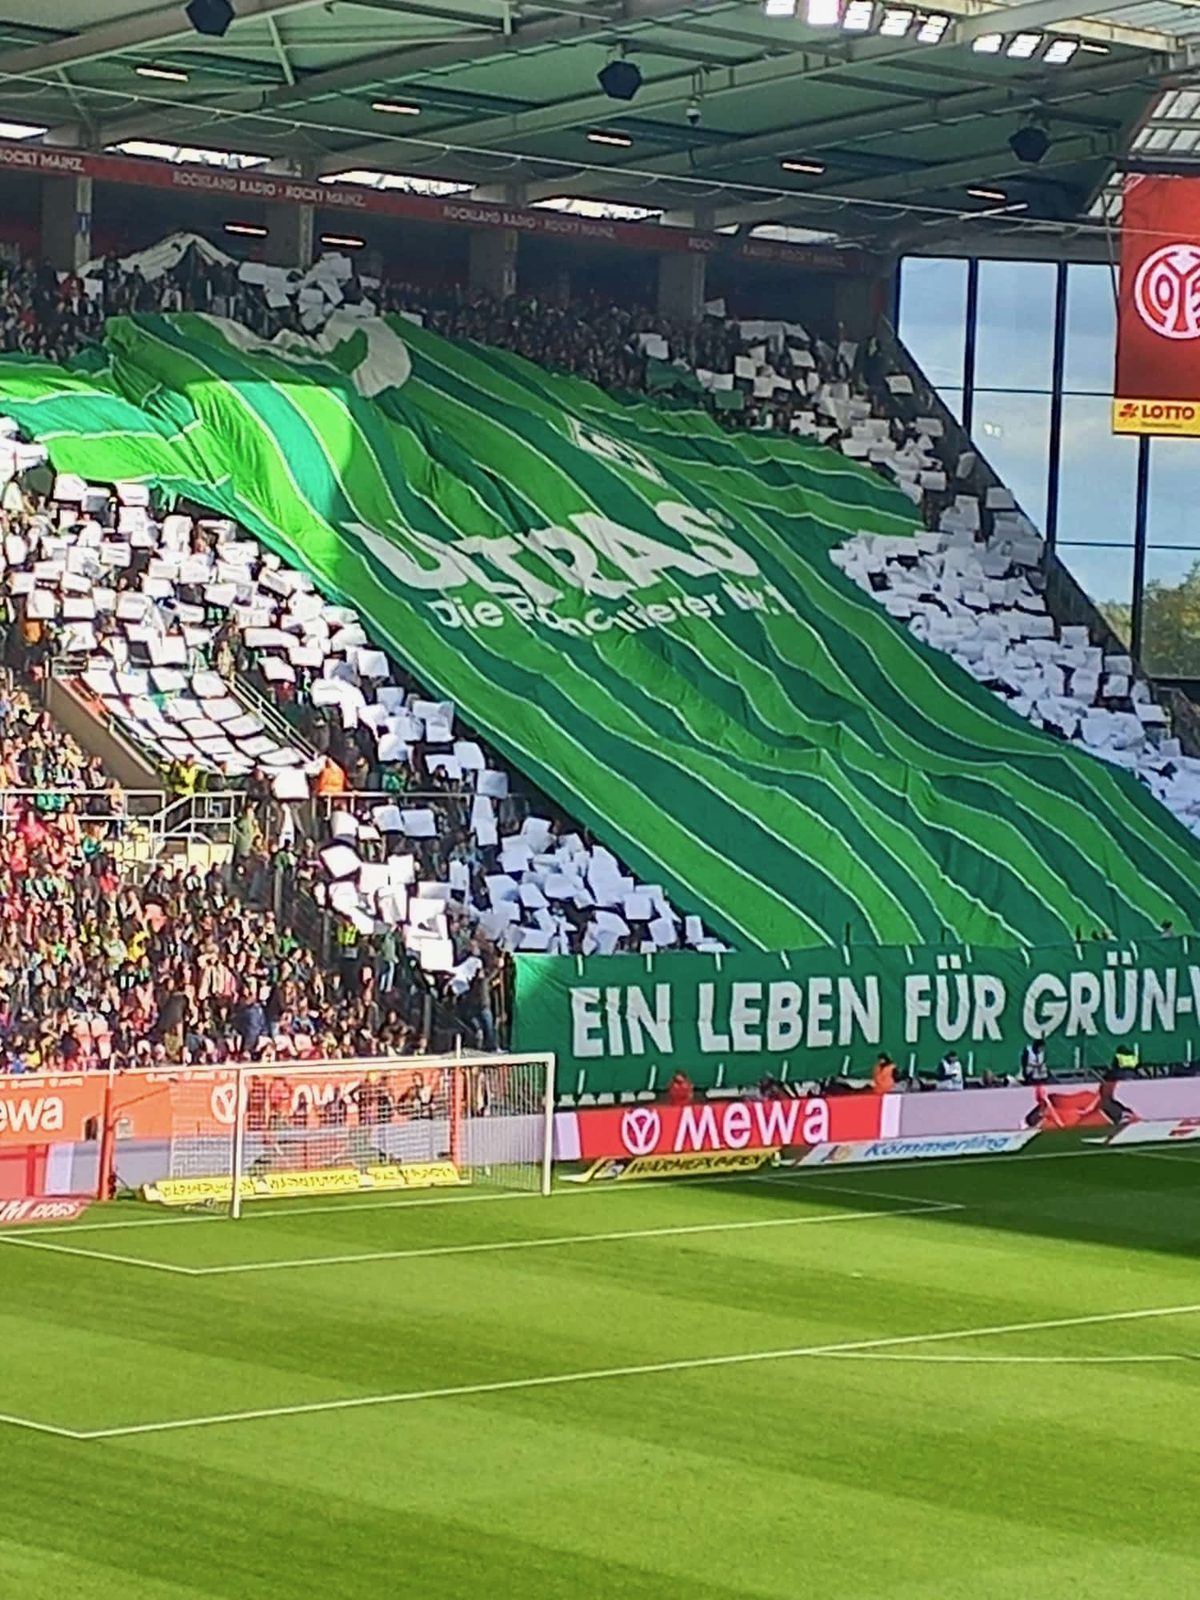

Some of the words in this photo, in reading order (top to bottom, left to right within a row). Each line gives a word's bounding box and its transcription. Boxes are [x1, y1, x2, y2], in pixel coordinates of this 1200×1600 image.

[1142, 404, 1195, 420] LOTTO
[426, 597, 504, 628] Die
[570, 983, 674, 1057] EIN
[698, 975, 881, 1052] LEBEN
[905, 954, 1006, 1043] FÜR
[1023, 950, 1200, 1040] GRÜN-
[864, 1135, 1010, 1158] Kömmerling
